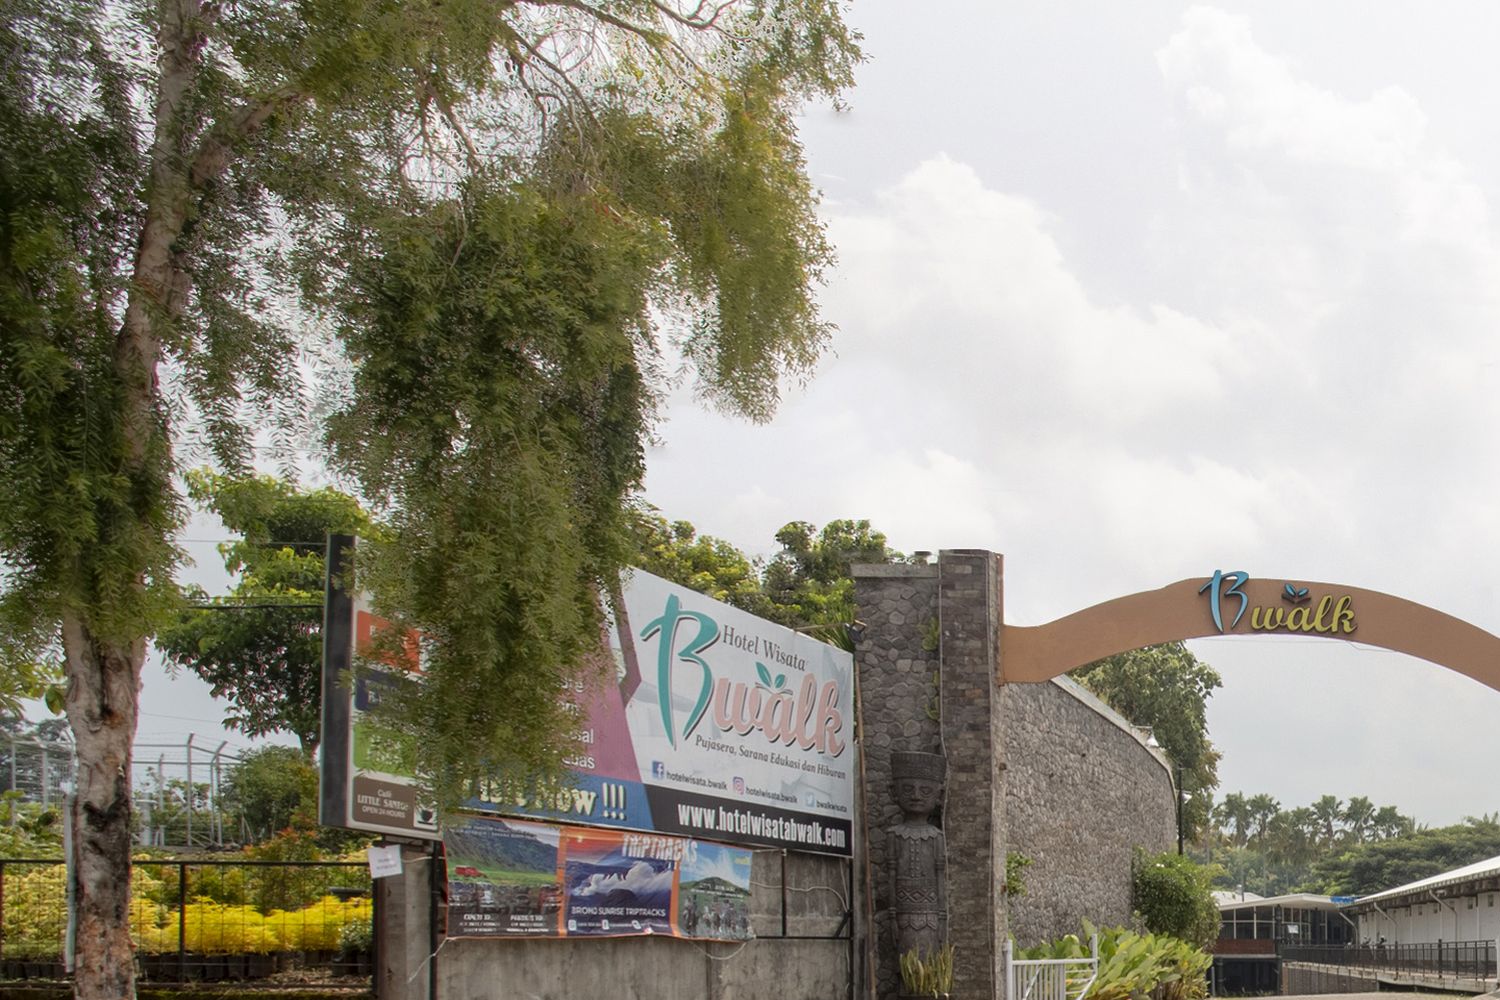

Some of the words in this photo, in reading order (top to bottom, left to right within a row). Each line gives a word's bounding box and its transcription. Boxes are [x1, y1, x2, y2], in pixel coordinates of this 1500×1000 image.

[722, 625, 759, 655] Hotel
[763, 639, 806, 672] Wisata
[639, 593, 845, 758] Bwalk
[739, 745, 769, 763] Sarana
[770, 753, 800, 769] Edukasi
[802, 760, 816, 773] dan
[817, 763, 846, 779] Hiburan
[666, 771, 728, 791] hotelwisata.bwalk
[677, 803, 846, 848] www.hotelwisatabwalk.com
[621, 831, 698, 864] TRIPTRACKS
[625, 907, 666, 917] TRIPTRACKS
